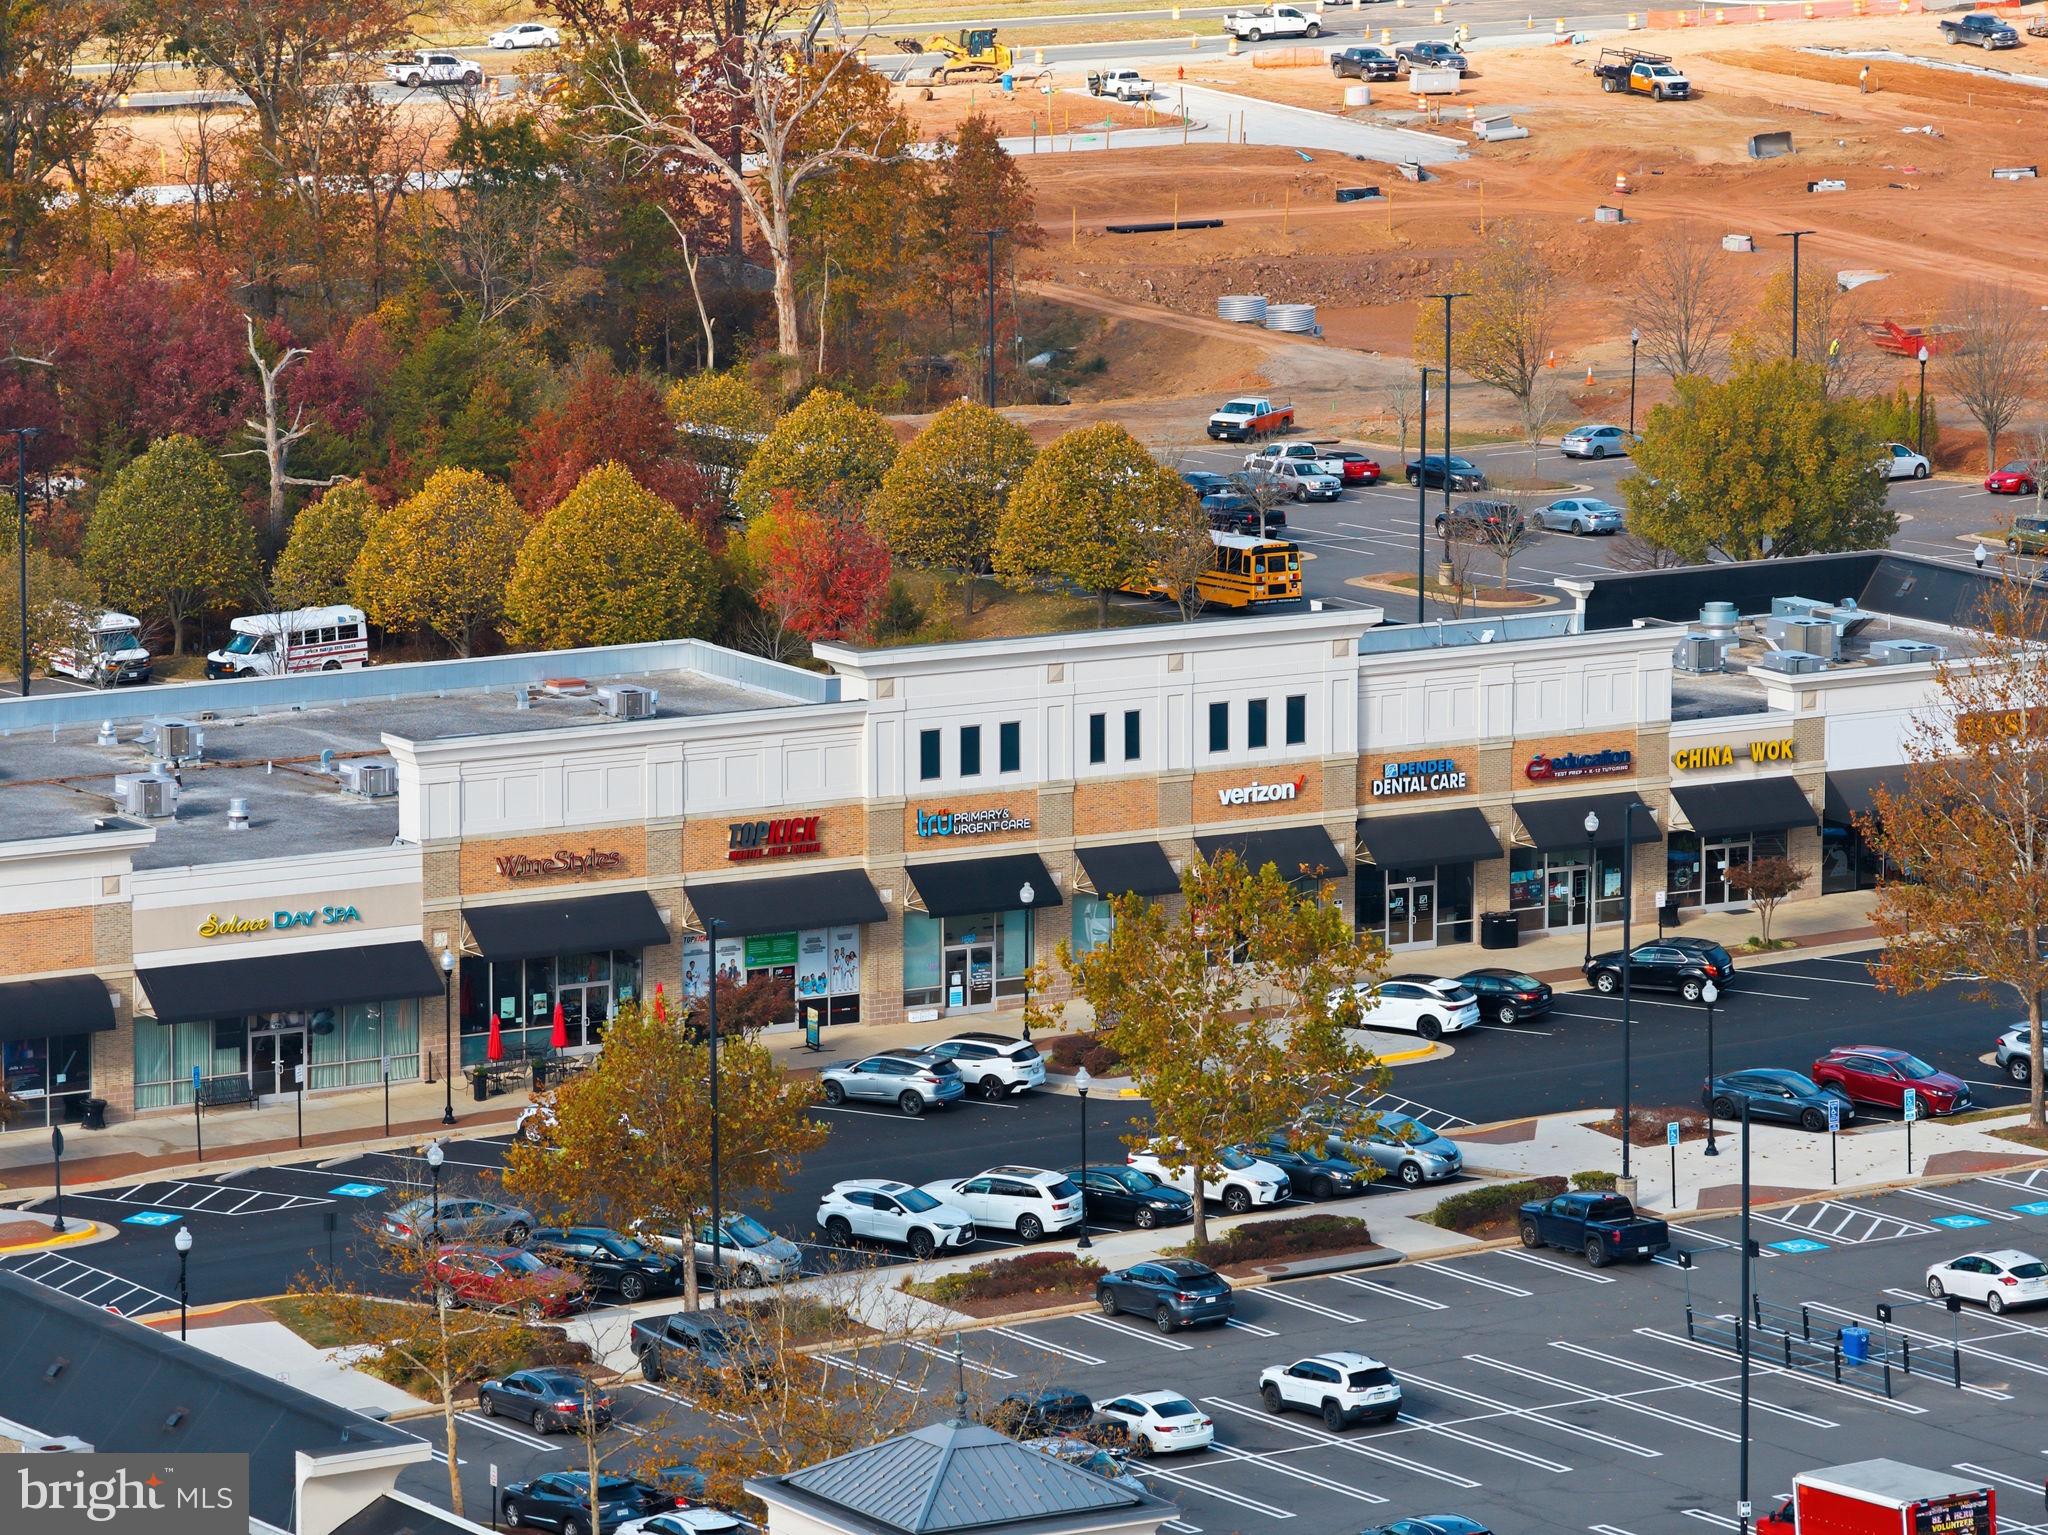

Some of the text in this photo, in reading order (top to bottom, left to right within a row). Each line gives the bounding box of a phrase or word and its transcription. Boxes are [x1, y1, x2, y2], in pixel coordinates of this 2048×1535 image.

[1675, 739, 1794, 769] CHINA WOK
[1398, 759, 1455, 776] PENDER
[1218, 781, 1296, 805] verizon
[1373, 772, 1466, 796] DENTAL CARE
[728, 816, 821, 849] TOPKICK
[953, 818, 1031, 835] URGENT CARE
[495, 847, 621, 877] WineStyles
[197, 903, 361, 939] Solace DAY SPA
[1931, 1518, 1975, 1532] VOLUNTEER
